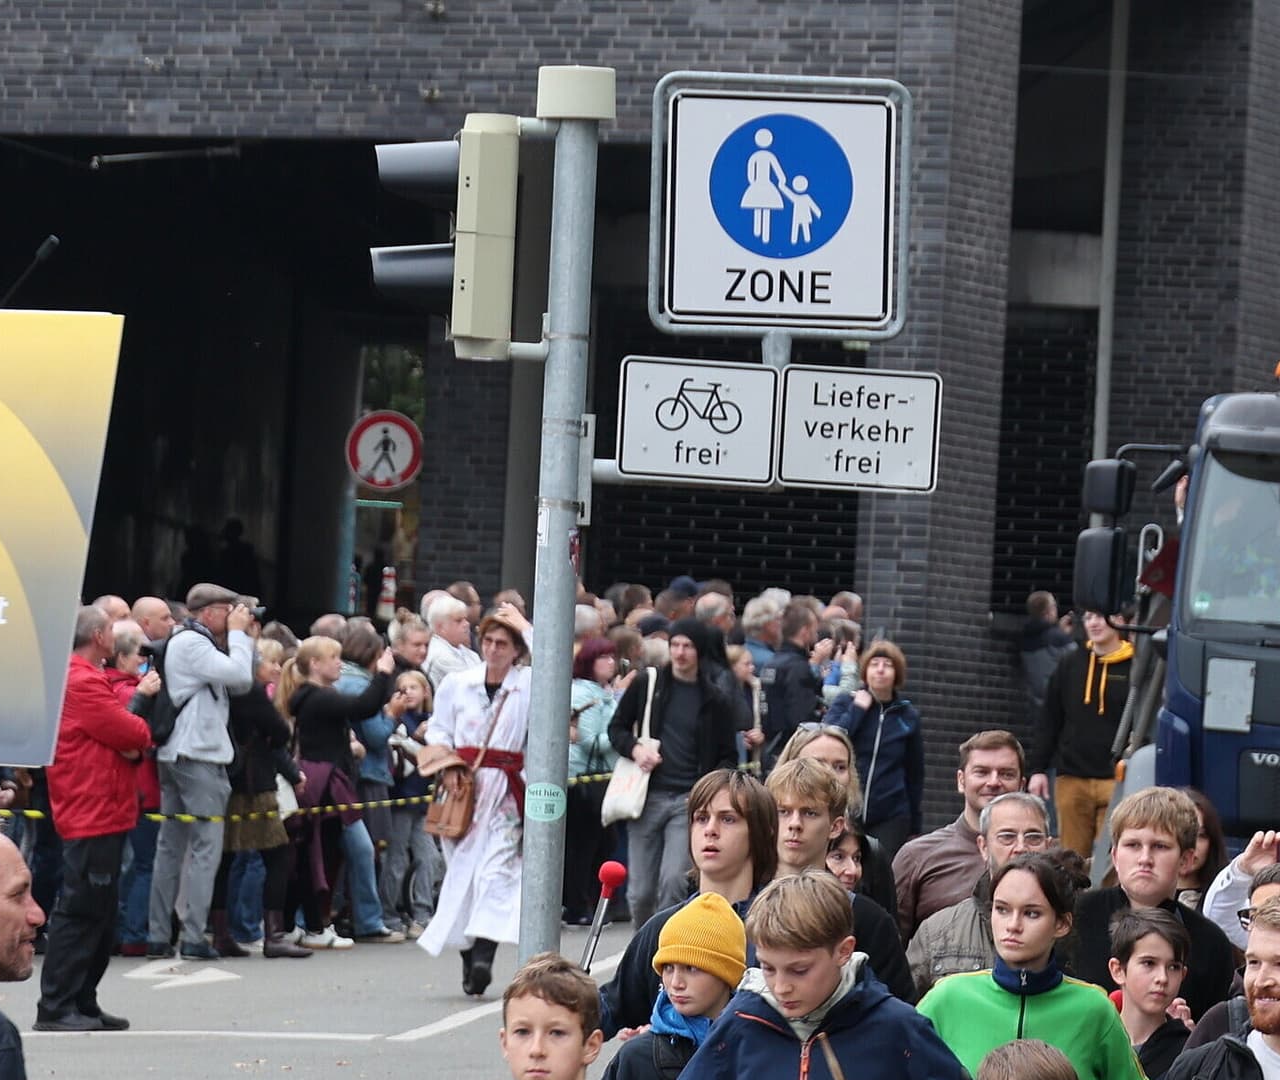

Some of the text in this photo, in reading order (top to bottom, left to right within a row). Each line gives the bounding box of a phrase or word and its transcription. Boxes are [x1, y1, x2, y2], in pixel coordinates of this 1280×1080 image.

[725, 268, 832, 304] ZONE
[814, 382, 908, 410] Liefer-
[804, 417, 914, 444] verkehr
[674, 441, 720, 465] frei
[834, 449, 881, 474] frei
